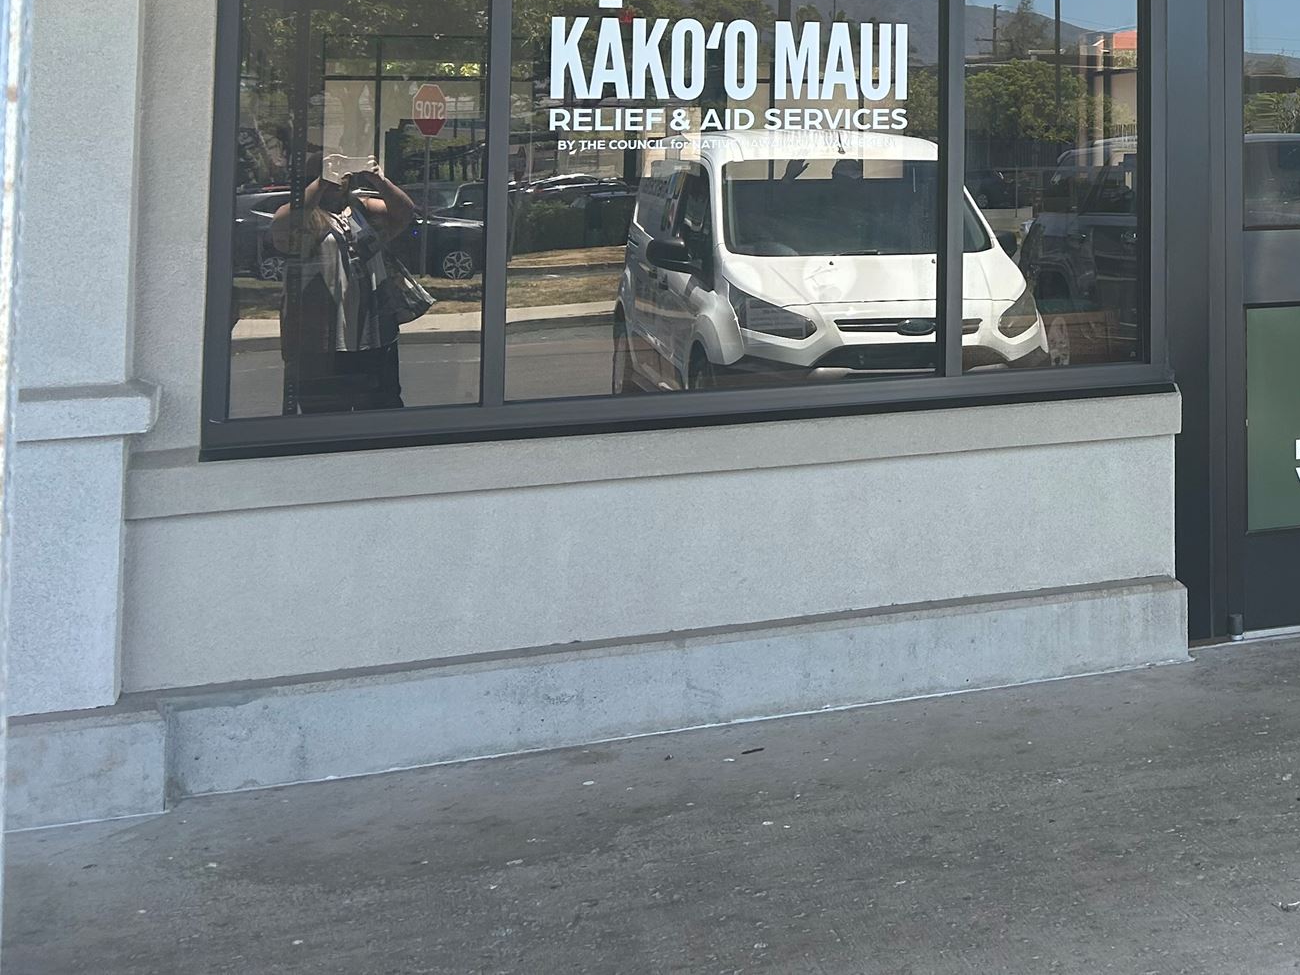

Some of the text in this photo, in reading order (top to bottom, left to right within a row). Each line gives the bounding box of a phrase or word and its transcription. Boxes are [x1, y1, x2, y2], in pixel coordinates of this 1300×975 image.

[775, 21, 908, 101] MAUI
[549, 108, 908, 132] RELIEF & AID SERVICES
[558, 140, 578, 151] BY
[579, 139, 607, 150] THE
[609, 139, 667, 150] COUNCIL
[671, 138, 689, 150] for
